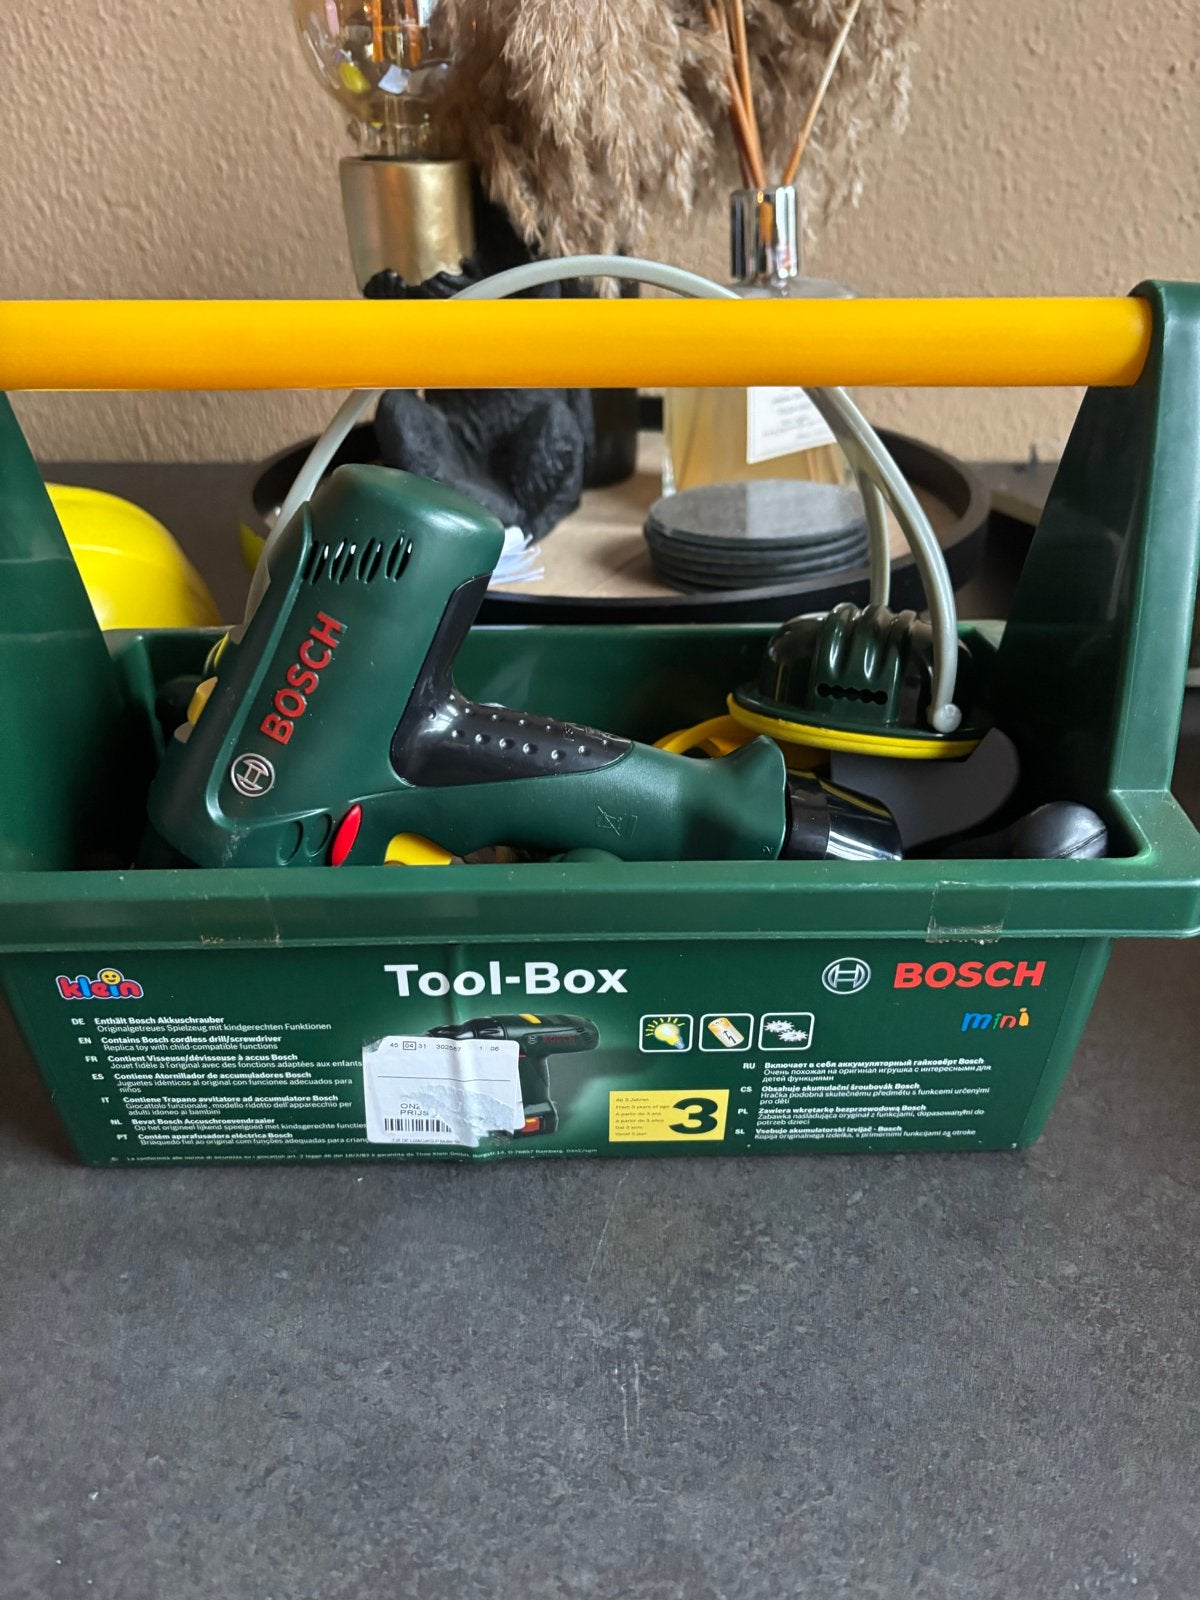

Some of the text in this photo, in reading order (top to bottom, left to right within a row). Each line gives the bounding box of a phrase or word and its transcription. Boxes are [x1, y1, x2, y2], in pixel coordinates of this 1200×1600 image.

[260, 611, 346, 745] BOSCH
[56, 969, 143, 999] klein
[384, 961, 628, 996] Tool-Box
[893, 961, 1047, 989] BOSCH
[94, 1016, 224, 1025] Enthält Bosch Akkuschrauber
[97, 1025, 165, 1033] Originalgetreues
[167, 1024, 208, 1032] Spielzeug
[224, 1023, 283, 1032] kindgerechten
[961, 1007, 1029, 1032] mini
[170, 1043, 238, 1051] child-compatible
[209, 1035, 282, 1043] drill/screwdriver
[669, 1097, 718, 1134] 3
